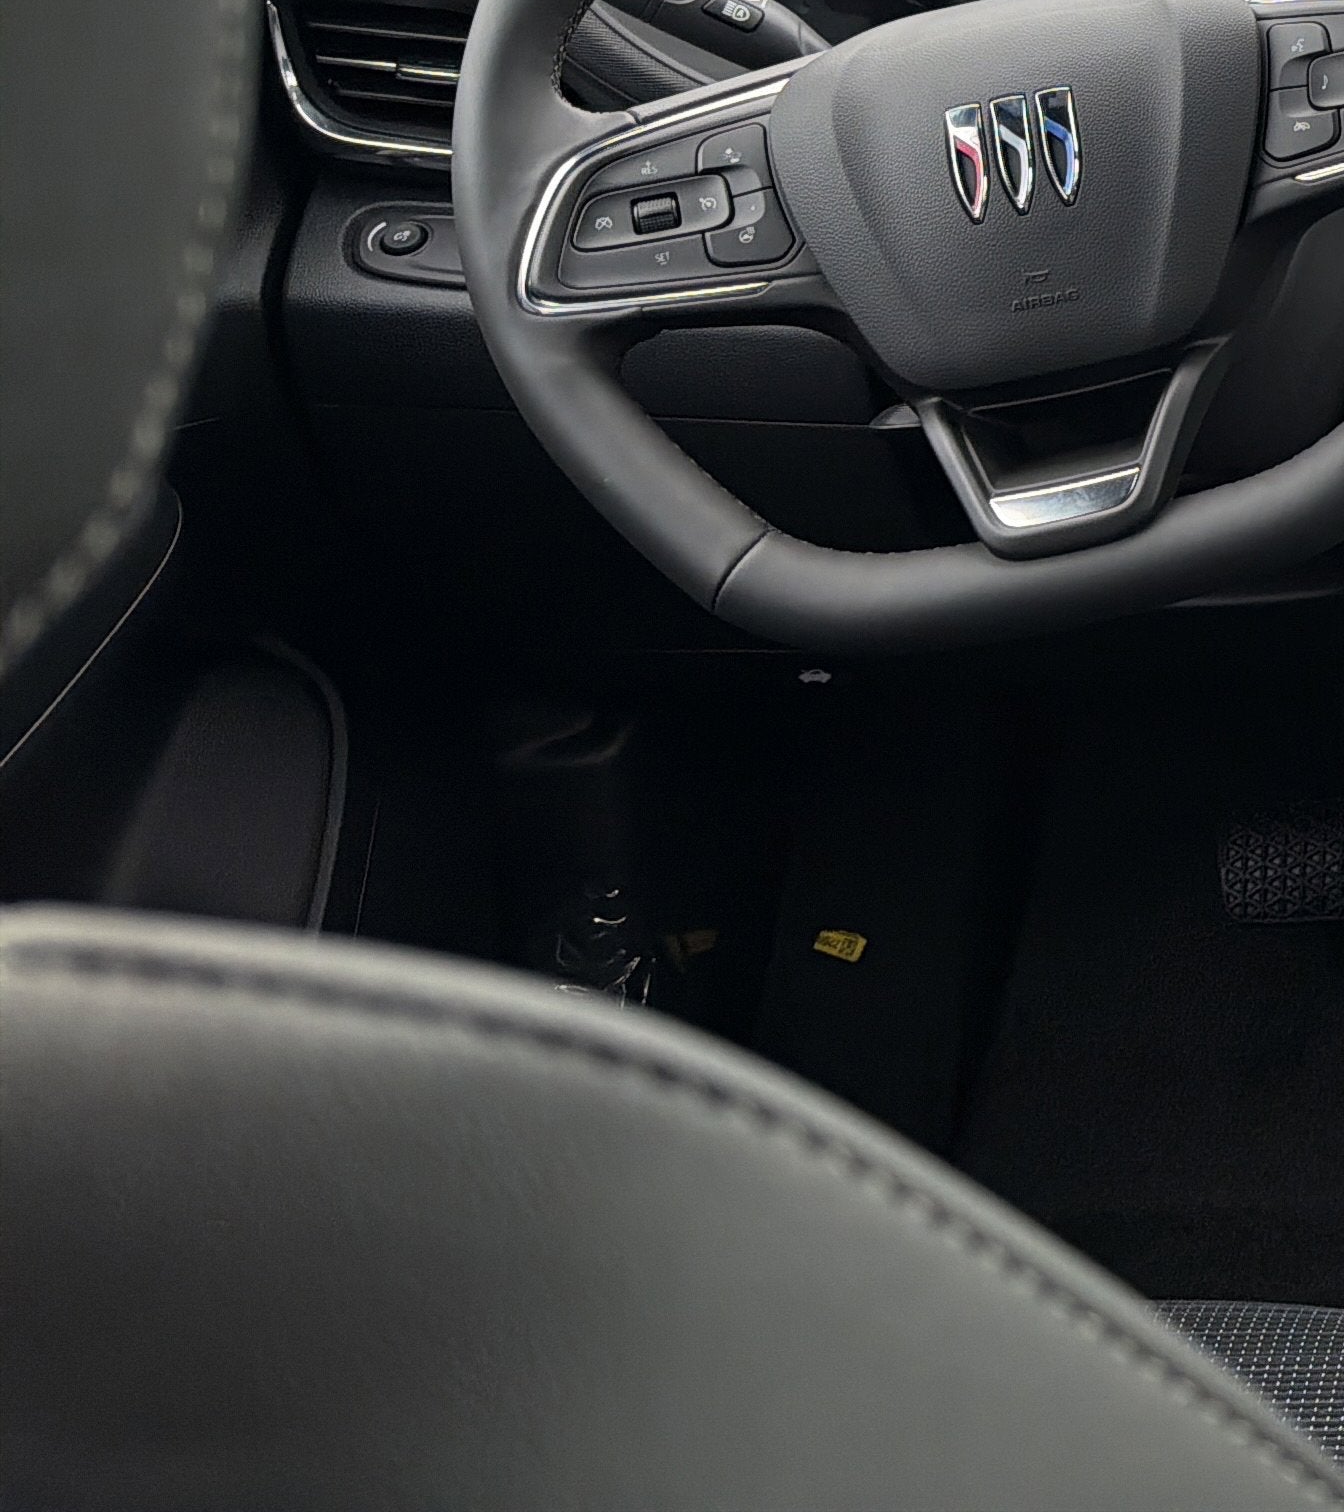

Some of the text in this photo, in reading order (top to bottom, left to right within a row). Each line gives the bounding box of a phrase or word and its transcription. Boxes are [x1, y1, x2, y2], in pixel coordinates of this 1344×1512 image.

[640, 166, 658, 176] RES
[654, 251, 671, 263] SET
[1011, 288, 1080, 313] AIRBAG
